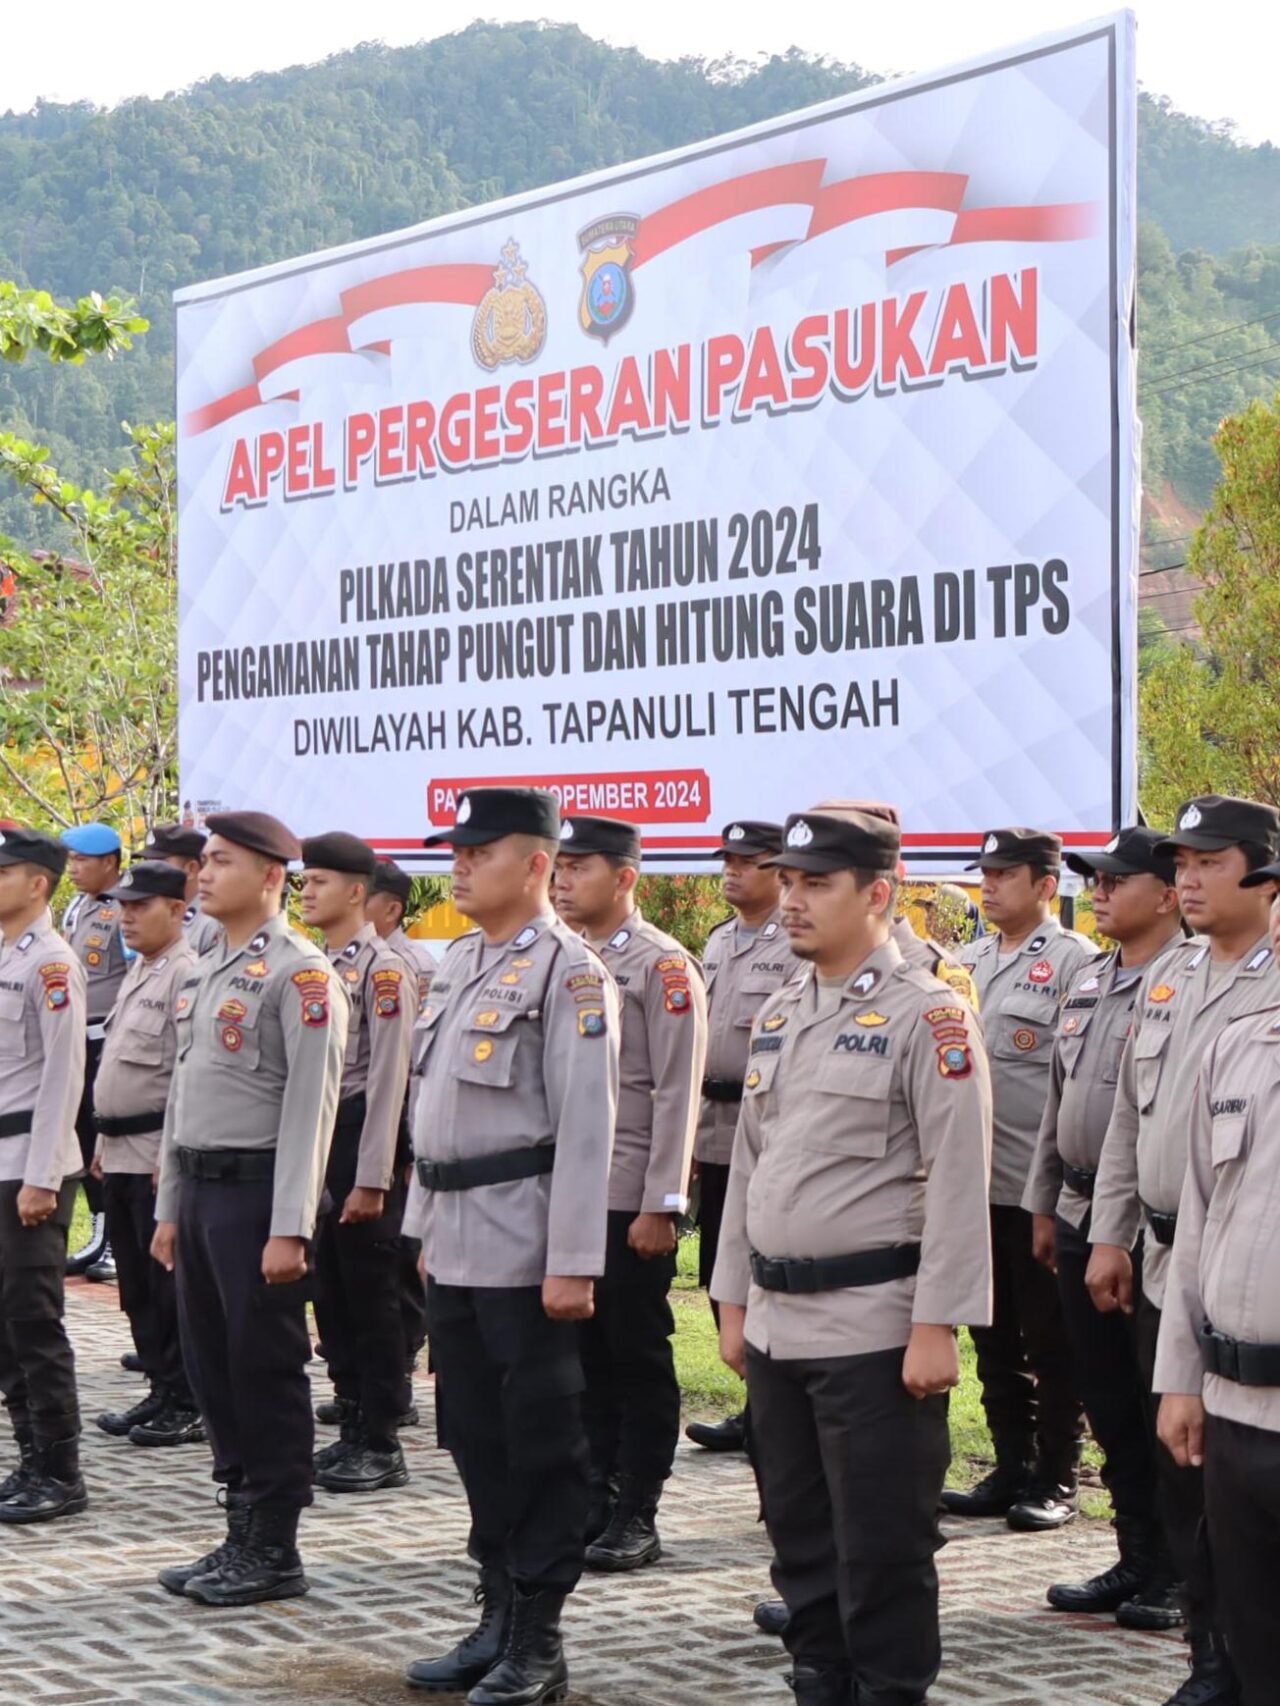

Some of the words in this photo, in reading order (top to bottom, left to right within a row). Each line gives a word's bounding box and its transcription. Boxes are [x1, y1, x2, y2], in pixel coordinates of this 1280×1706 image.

[224, 423, 335, 503] APEL
[347, 346, 691, 482] PERGESERAN
[707, 267, 1038, 416] PASUKAN
[449, 488, 538, 534] DALAM
[548, 467, 671, 519] RANGKA
[339, 552, 450, 624] PILKADA
[456, 533, 603, 612] SERENTAK
[610, 517, 718, 592] TAHUN
[727, 503, 822, 580] 2024
[197, 636, 360, 702] PENGAMANAN
[366, 627, 450, 691] TAHAP
[458, 614, 574, 683] PUNGUT
[582, 606, 647, 674] DAN
[656, 590, 784, 667] HITUNG
[794, 575, 924, 656] SUARA
[933, 569, 976, 643] DI
[986, 558, 1070, 639] TPS
[294, 710, 446, 756] DIWILAYAH
[457, 705, 532, 749] KAB.
[542, 691, 716, 746] TAPANULI
[727, 678, 899, 734] TENGAH
[532, 782, 649, 810] OPEMBER
[654, 780, 701, 808] 2024
[751, 962, 784, 973] POLRI
[228, 976, 265, 994] POLRI
[482, 988, 523, 1004] POLISI
[1014, 982, 1057, 997] POLRI
[139, 999, 165, 1011] POLRI
[833, 1033, 889, 1055] POLRI
